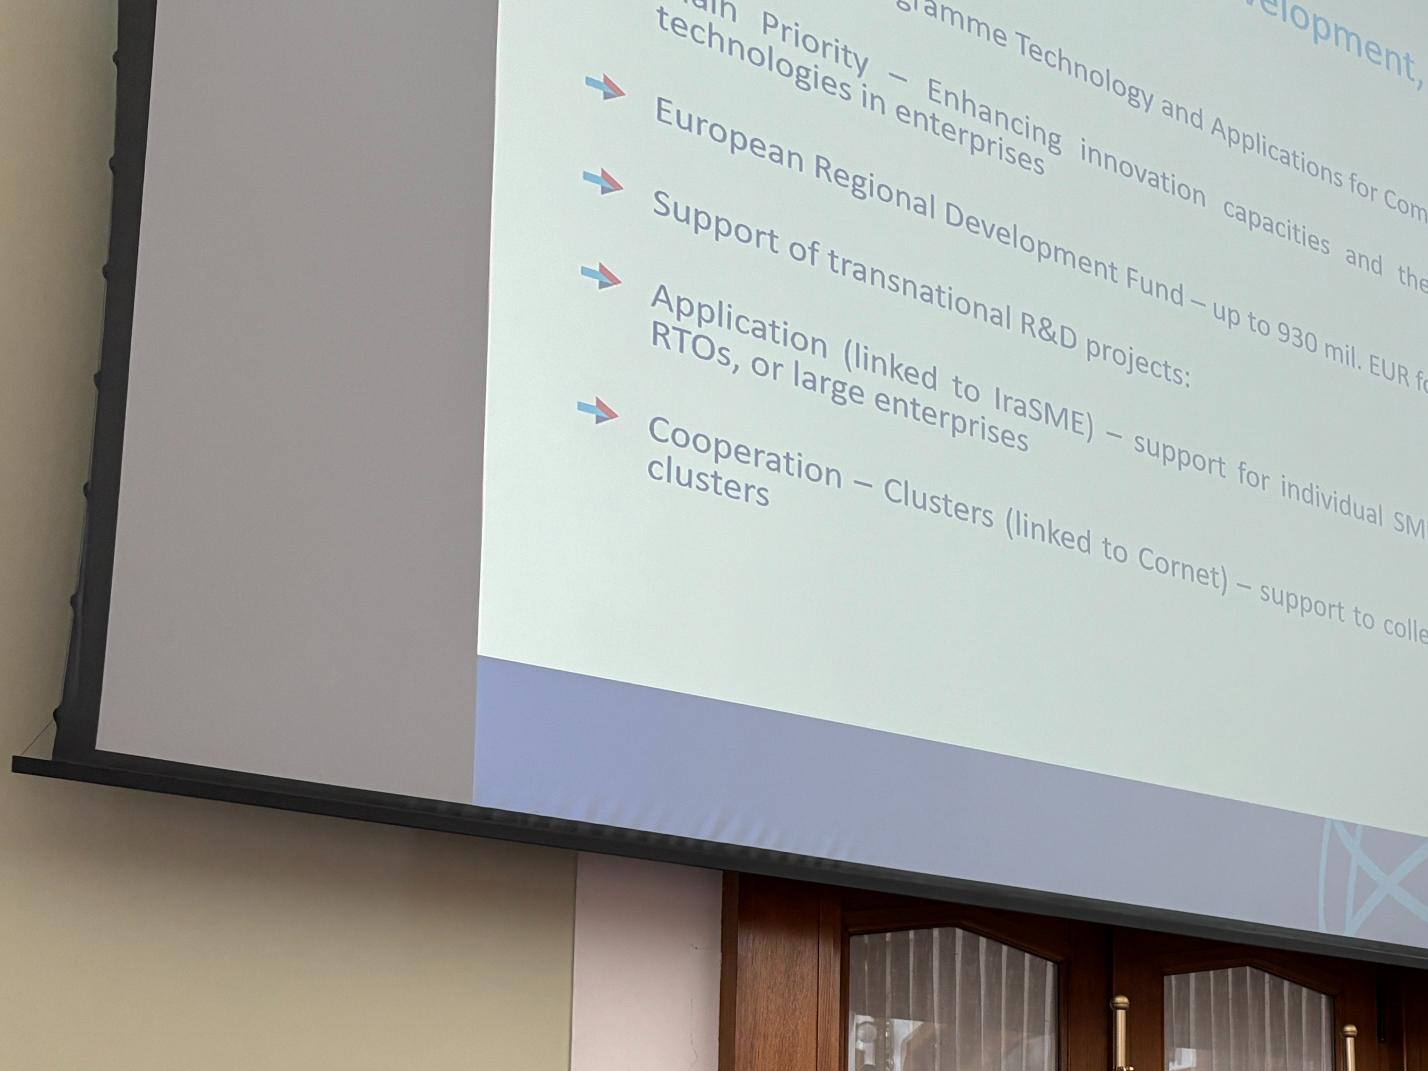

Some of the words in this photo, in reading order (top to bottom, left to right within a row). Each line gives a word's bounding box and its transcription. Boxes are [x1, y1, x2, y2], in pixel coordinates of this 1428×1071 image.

[655, 5, 853, 102] technologies
[861, 82, 886, 116] in
[895, 103, 1045, 176] enterprises
[683, 0, 738, 23] ain
[761, 9, 870, 80] Priority
[928, 77, 1063, 157] Enhancing
[1080, 136, 1206, 208] innovation
[1223, 200, 1331, 255] capacities
[1345, 248, 1383, 277] and
[1014, 30, 1155, 114] Technology
[1161, 99, 1204, 132] and
[1210, 116, 1344, 188] Applications
[1348, 172, 1379, 202] for
[1245, 0, 1424, 92] elopment,
[653, 190, 780, 255] Support
[788, 240, 821, 267] of
[826, 249, 1011, 331] transnational
[1021, 311, 1078, 350] R&D
[1086, 337, 1190, 389] projects:
[656, 96, 804, 173] European
[815, 154, 935, 220] Regional
[945, 201, 1119, 284] Development
[1126, 266, 1184, 308] Fund
[1212, 301, 1241, 330] up
[1247, 311, 1271, 337] to
[1277, 321, 1318, 354] 930
[1324, 342, 1362, 371] mil.
[1369, 353, 1410, 388] EUR
[649, 283, 828, 360] Application
[843, 337, 939, 392] (linked
[951, 374, 982, 403] to
[993, 386, 1094, 444] IraSME)
[1133, 435, 1227, 479] support
[1237, 460, 1271, 492] for
[1281, 473, 1383, 528] individual
[652, 319, 740, 375] RTOs,
[751, 356, 785, 381] or
[793, 359, 865, 407] large
[874, 391, 1029, 453] enterprises
[647, 454, 770, 507] clusters
[648, 416, 842, 489] Cooperation
[884, 478, 994, 529] Clusters
[1005, 506, 1091, 556] (linked
[1101, 536, 1129, 564] to
[1138, 546, 1228, 597] Cornet)
[1259, 584, 1346, 623] support
[1352, 605, 1376, 631] to
